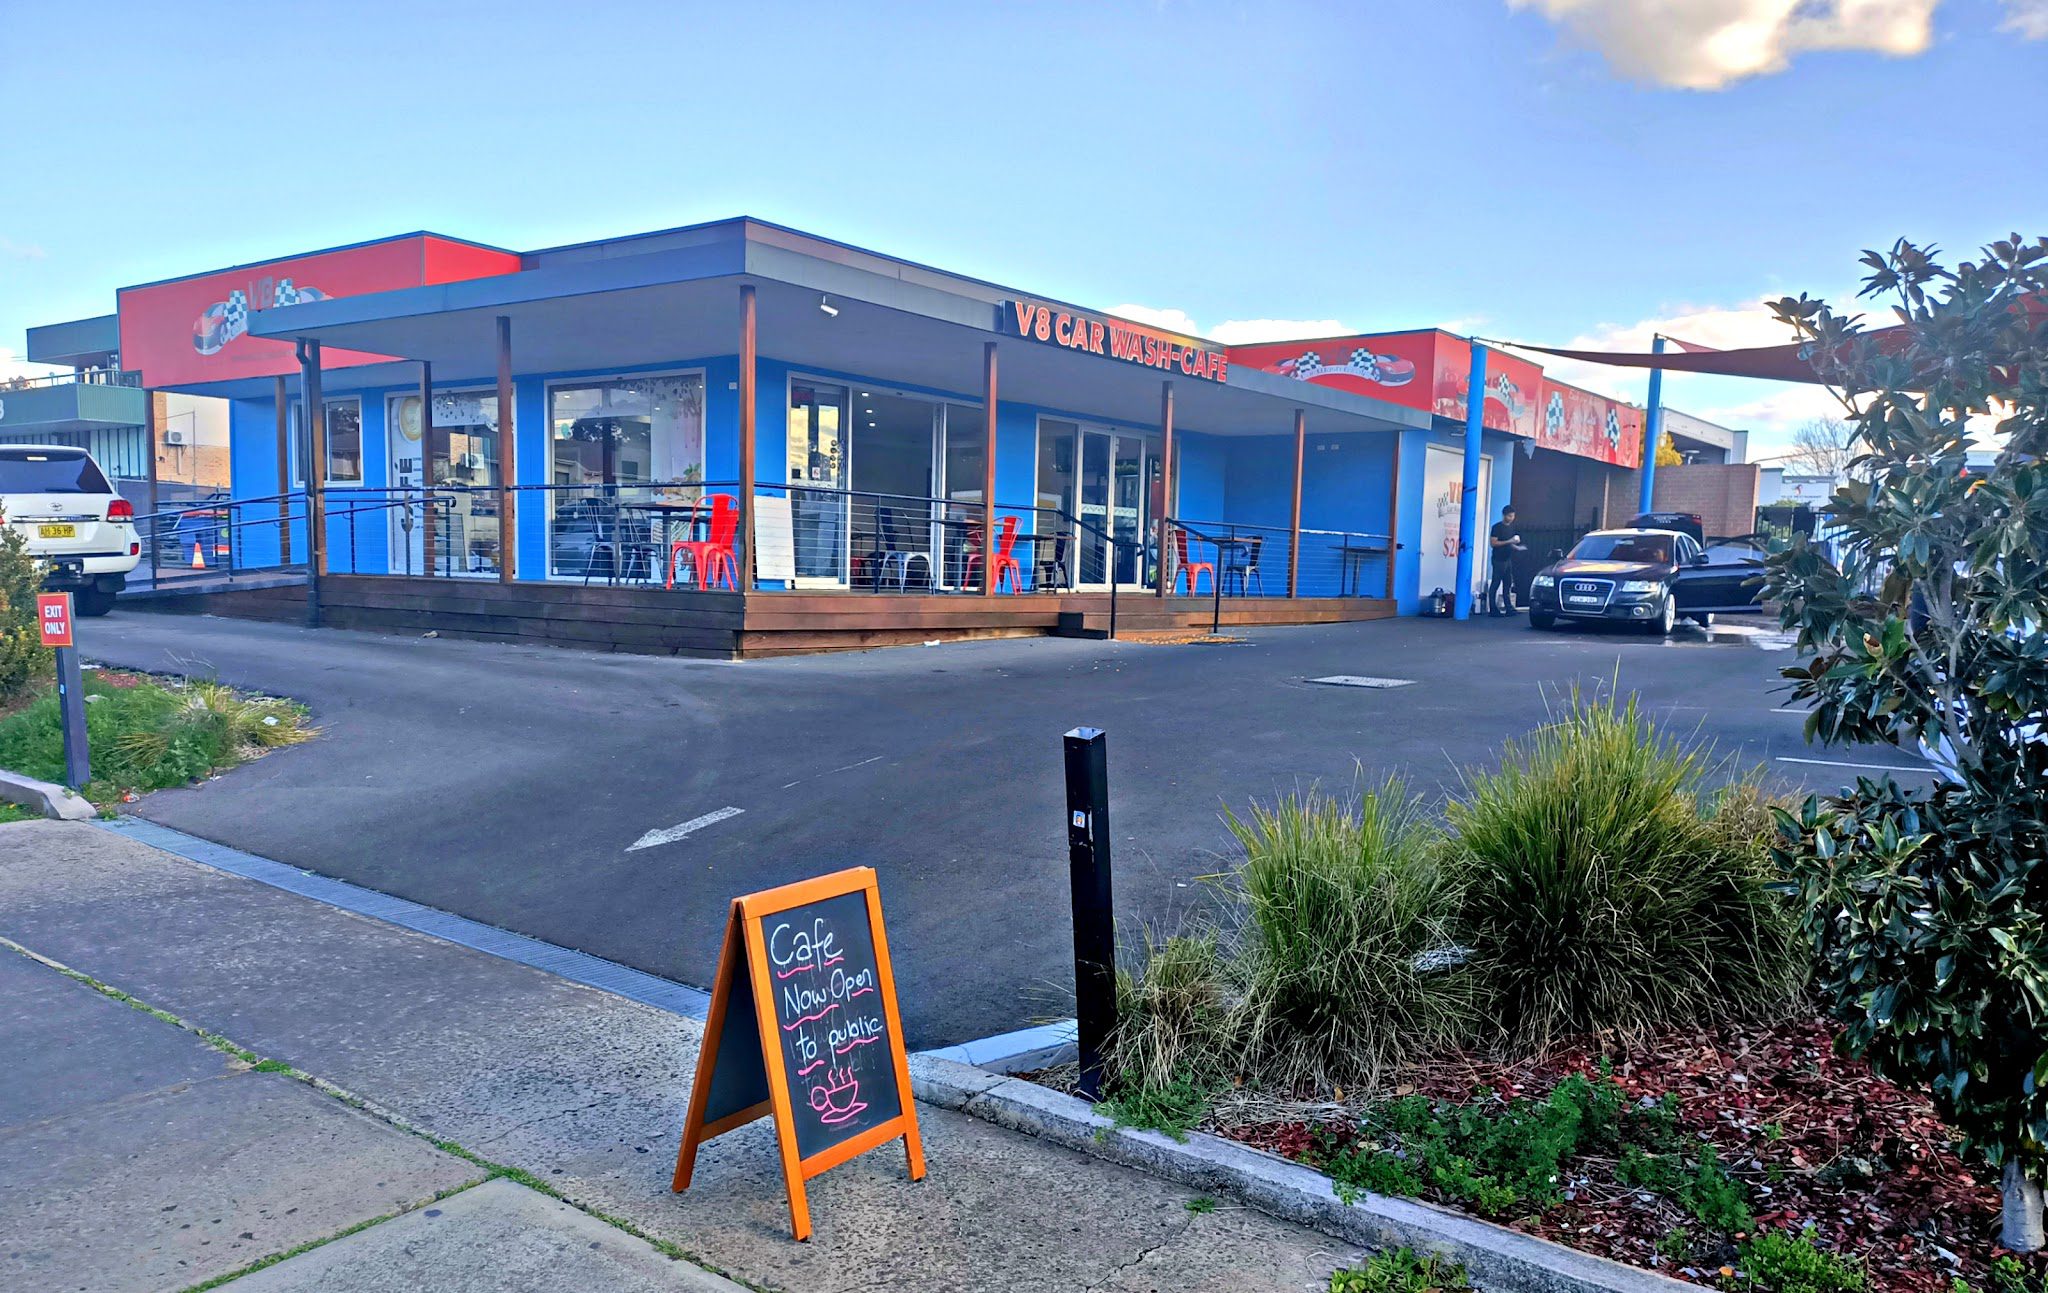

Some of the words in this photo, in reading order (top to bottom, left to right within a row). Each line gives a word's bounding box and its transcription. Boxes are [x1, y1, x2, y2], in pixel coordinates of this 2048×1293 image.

[1015, 301, 1051, 342] V8
[1055, 312, 1105, 355] CAR
[1109, 325, 1229, 383] WASH-CAFE
[44, 605, 63, 618] EXIT
[45, 621, 66, 635] ONLY
[770, 918, 843, 972] Cafe
[784, 983, 827, 1019] Now
[831, 968, 872, 1002] Open
[796, 1026, 818, 1061] to
[829, 1016, 883, 1070] public
